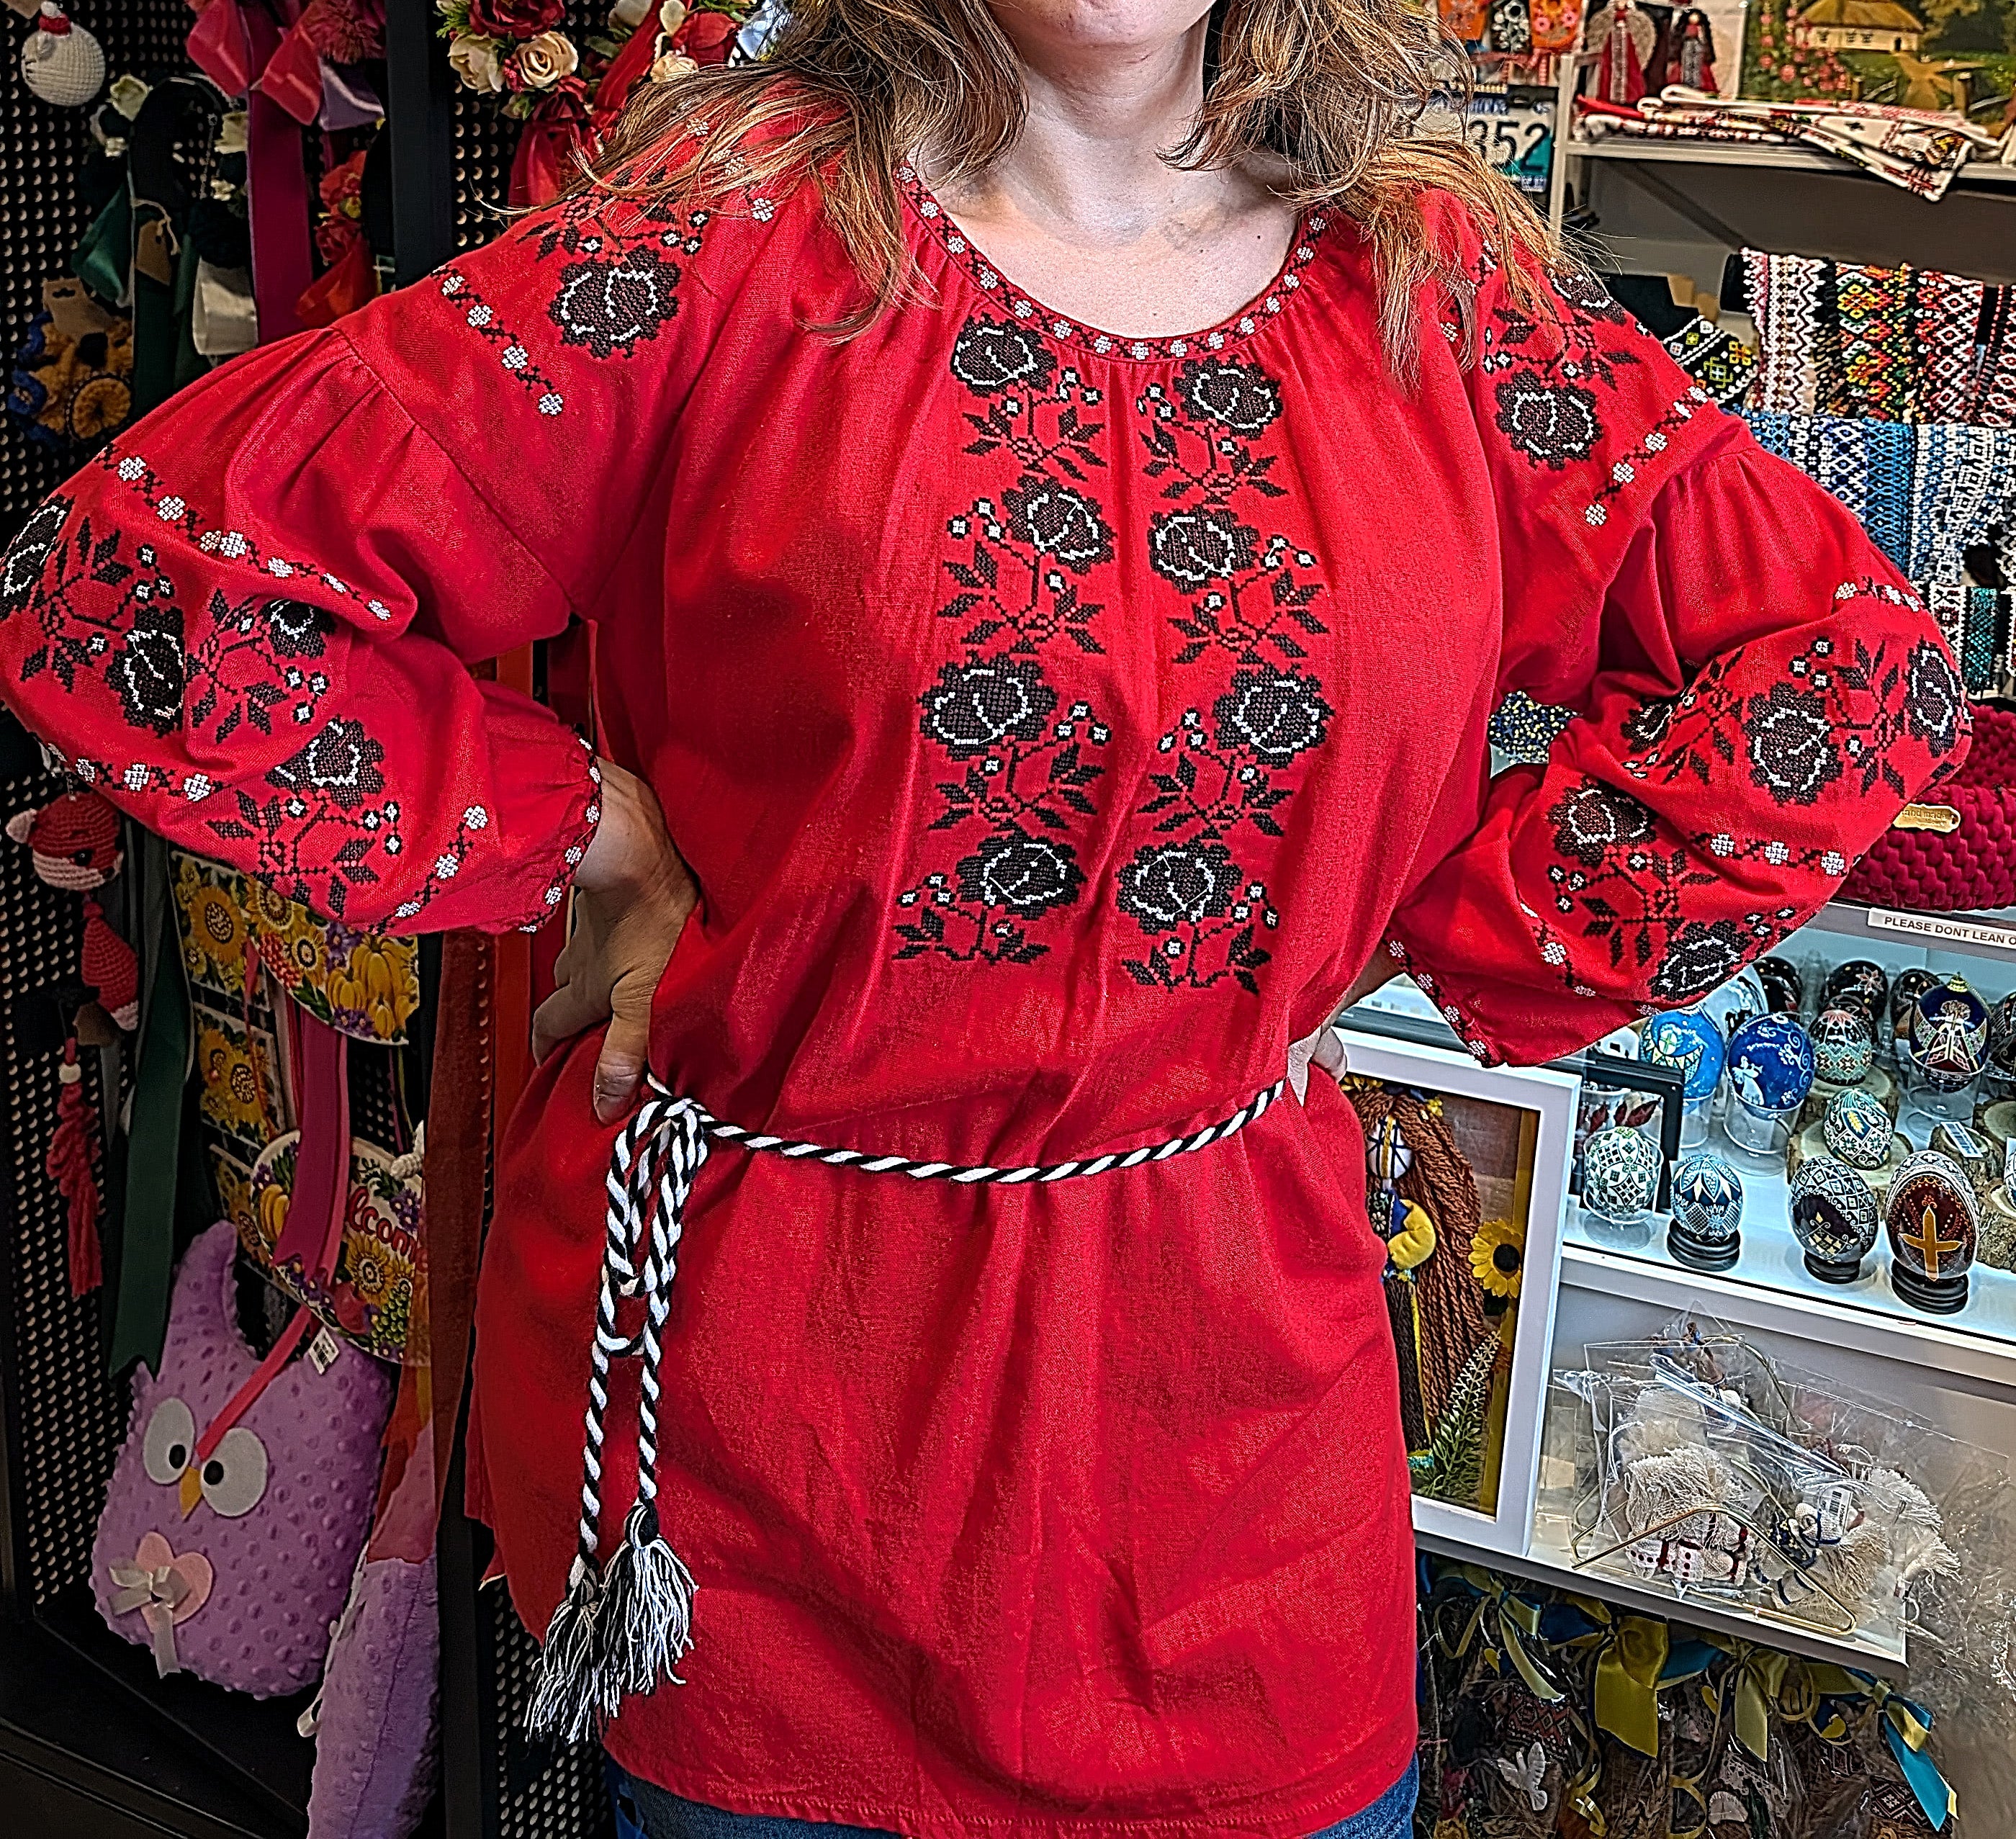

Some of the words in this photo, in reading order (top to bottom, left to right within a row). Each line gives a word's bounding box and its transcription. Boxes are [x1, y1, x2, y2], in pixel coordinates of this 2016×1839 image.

[1884, 916, 1932, 932] PLEASE
[1935, 925, 1969, 938] DONT
[1972, 930, 2005, 944] LEAN
[347, 1185, 426, 1270] lcom
